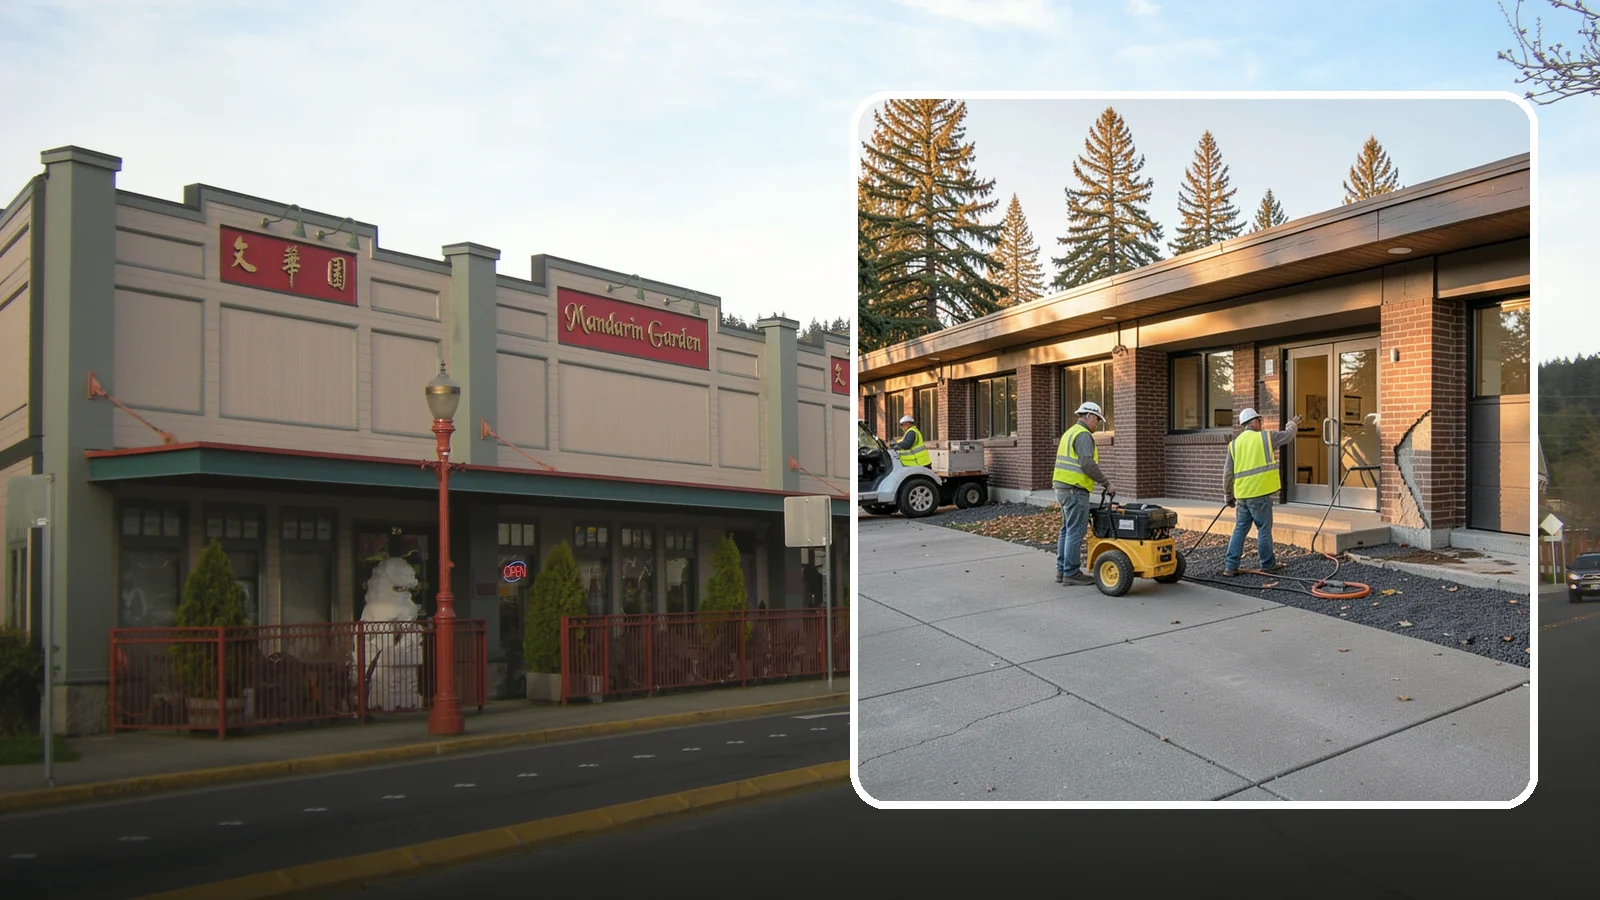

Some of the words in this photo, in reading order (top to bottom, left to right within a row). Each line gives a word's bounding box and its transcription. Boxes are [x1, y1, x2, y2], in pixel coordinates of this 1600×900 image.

[231, 235, 347, 291] 文華園
[564, 302, 644, 341] Mandarin
[648, 320, 701, 352] Garden
[834, 363, 846, 387] 文
[503, 565, 527, 578] OPEN
